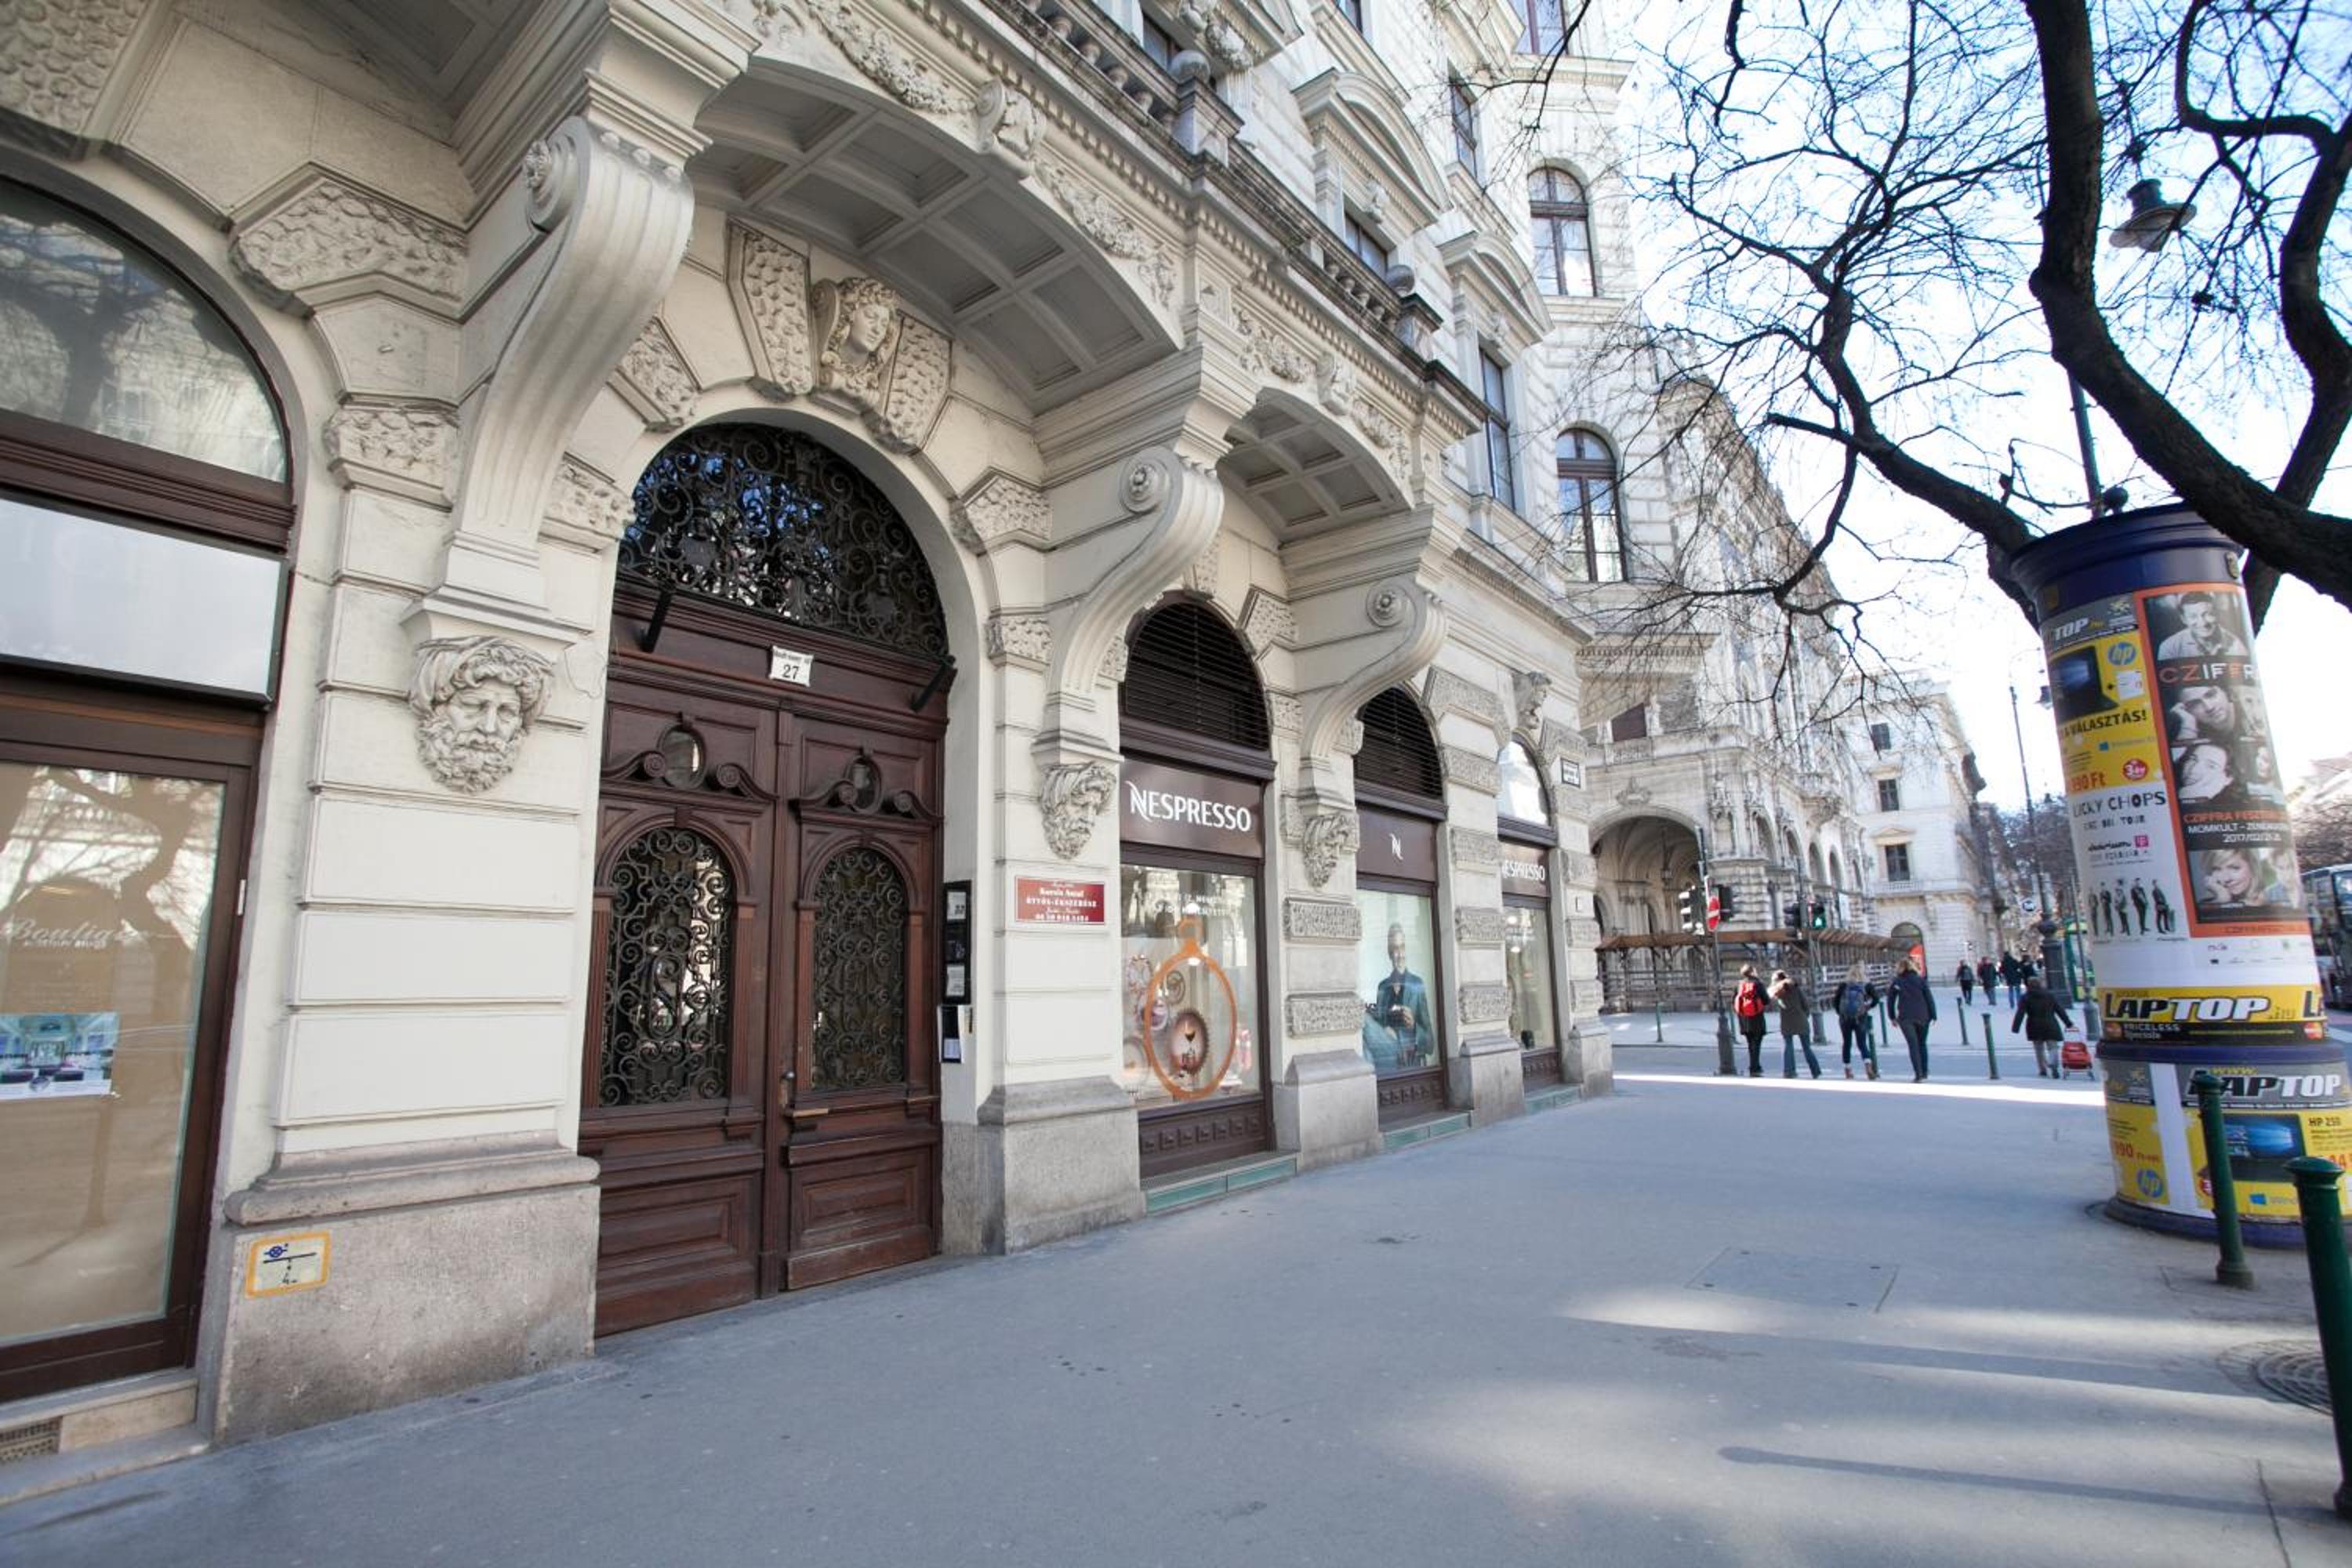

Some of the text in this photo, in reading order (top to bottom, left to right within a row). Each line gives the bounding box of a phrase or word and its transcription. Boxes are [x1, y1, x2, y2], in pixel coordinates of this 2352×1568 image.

[782, 663, 800, 680] 27
[2159, 662, 2260, 684] CZIFFR
[1124, 780, 1252, 833] NESPRESSO
[2108, 791, 2166, 811] CHOPS
[2105, 992, 2270, 1021] LAPTOP
